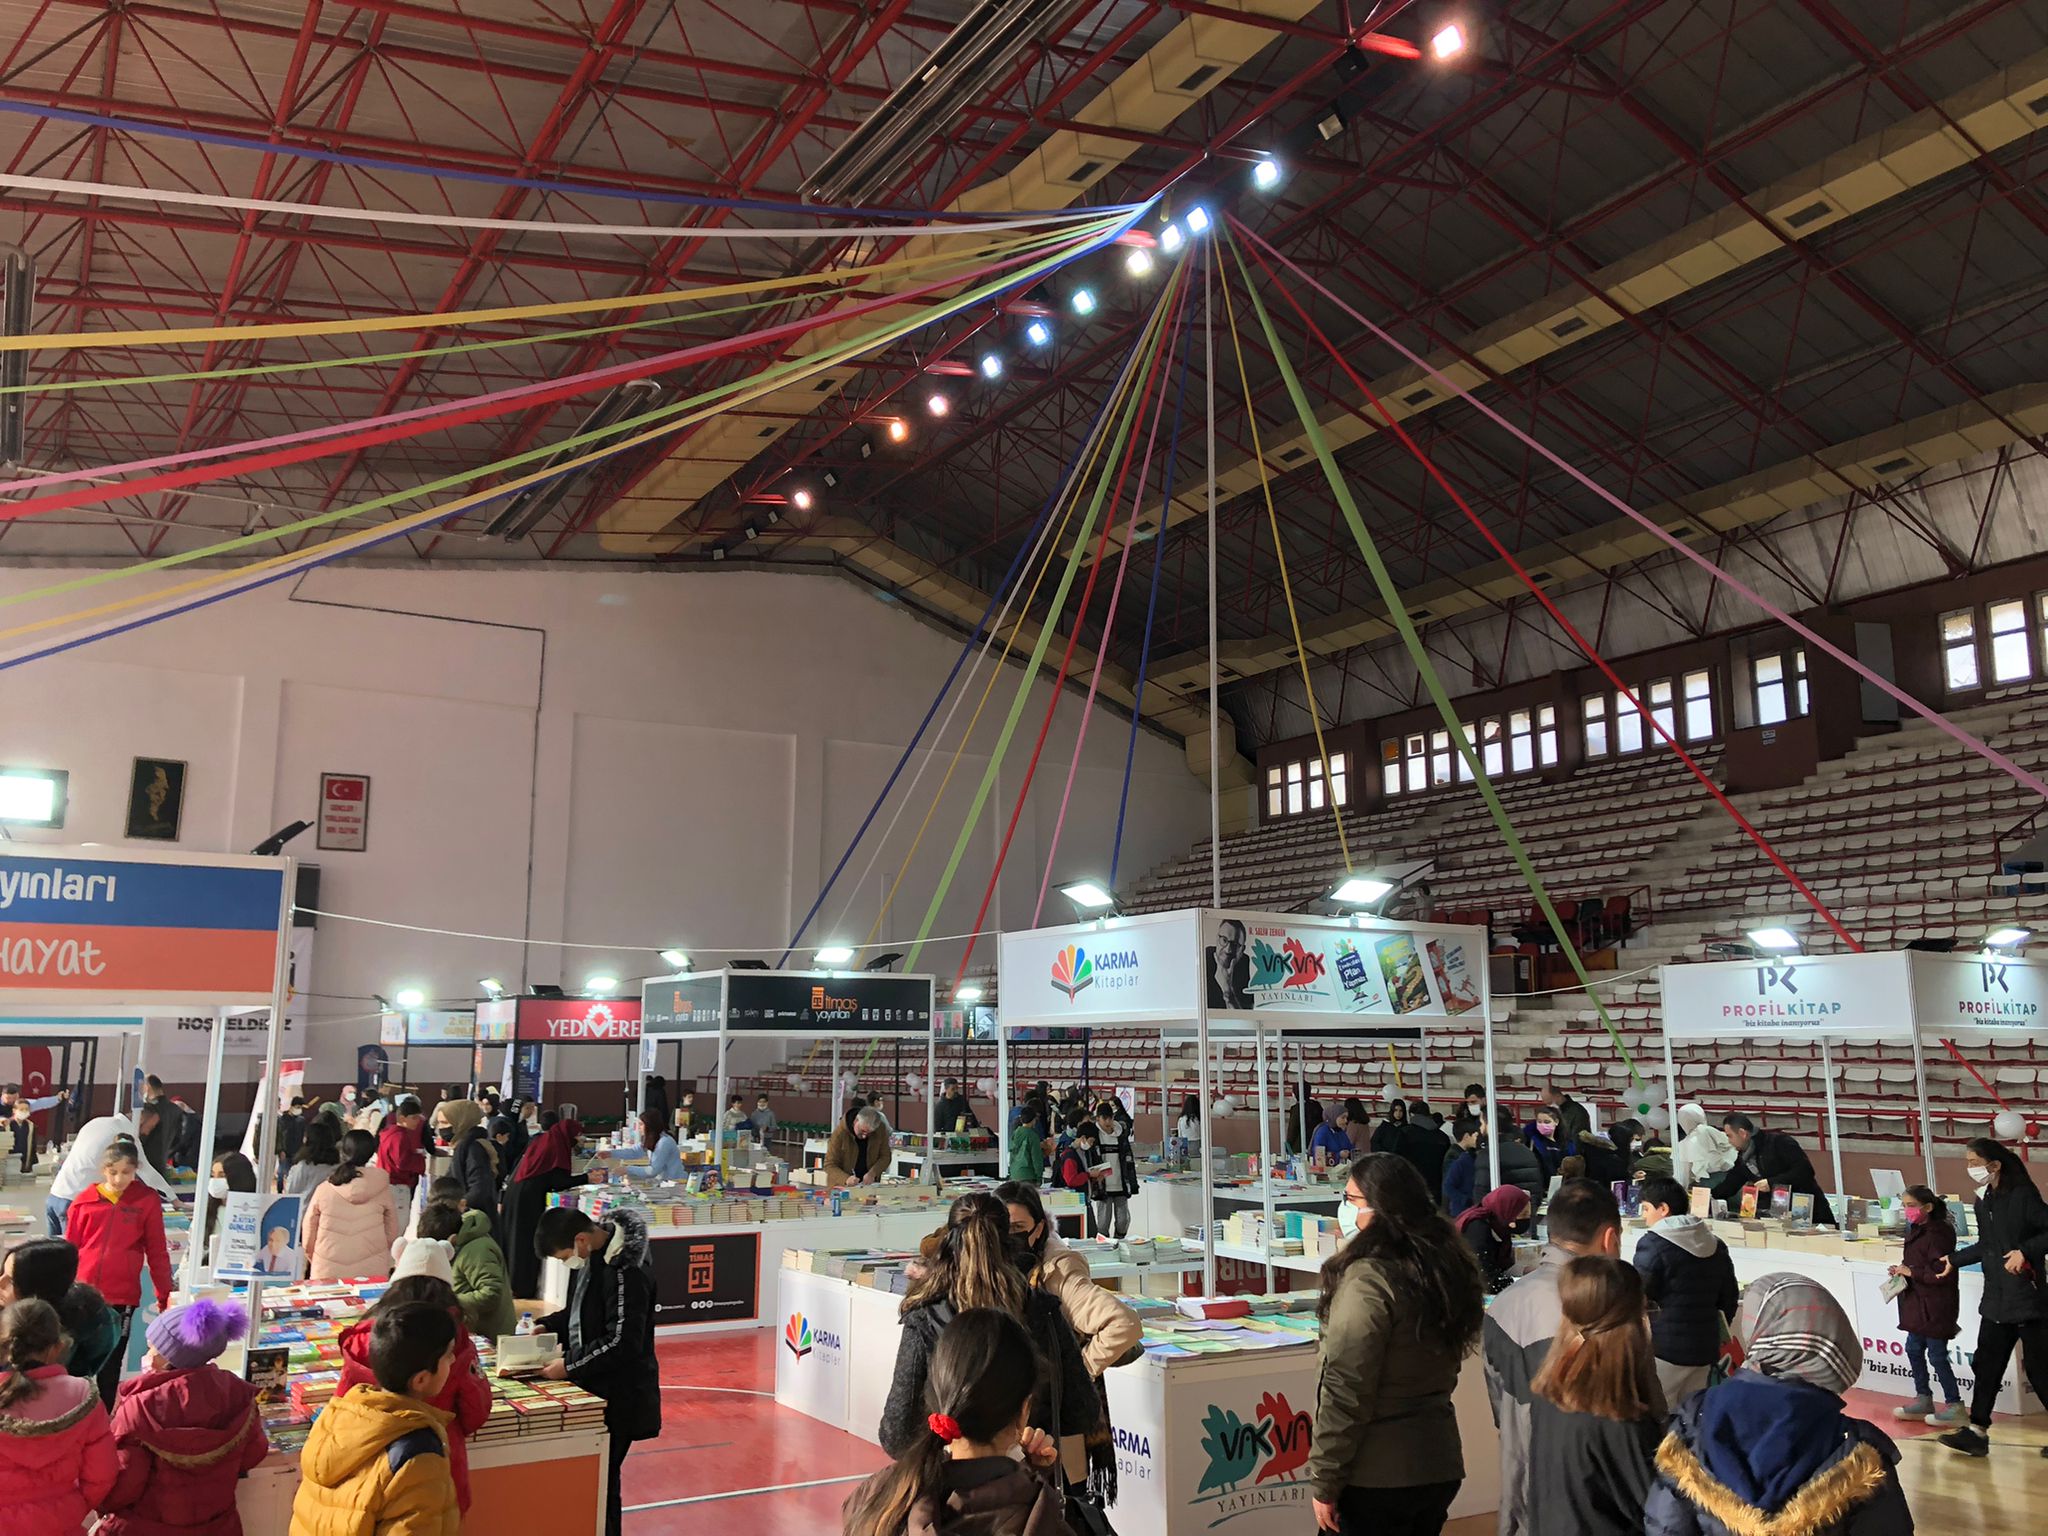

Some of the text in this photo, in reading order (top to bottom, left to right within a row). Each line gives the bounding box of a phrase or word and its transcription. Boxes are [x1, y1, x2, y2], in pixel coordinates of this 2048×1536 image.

[1094, 950, 1139, 971] KARMA
[1262, 952, 1294, 975] VAK
[1294, 952, 1326, 976] VAK
[1094, 974, 1139, 990] Kitaplar
[1722, 1000, 1842, 1017] PROFİLKİTAP
[1959, 998, 2038, 1015] PROFİLKİTAP
[177, 1017, 292, 1033] HOŞELDİZ
[813, 1327, 841, 1351] KARMA
[1110, 1426, 1152, 1459] ARMA
[1220, 1417, 1274, 1462] VAK
[1118, 1457, 1152, 1480] aplar
[1217, 1487, 1307, 1513] YAYINLARI
